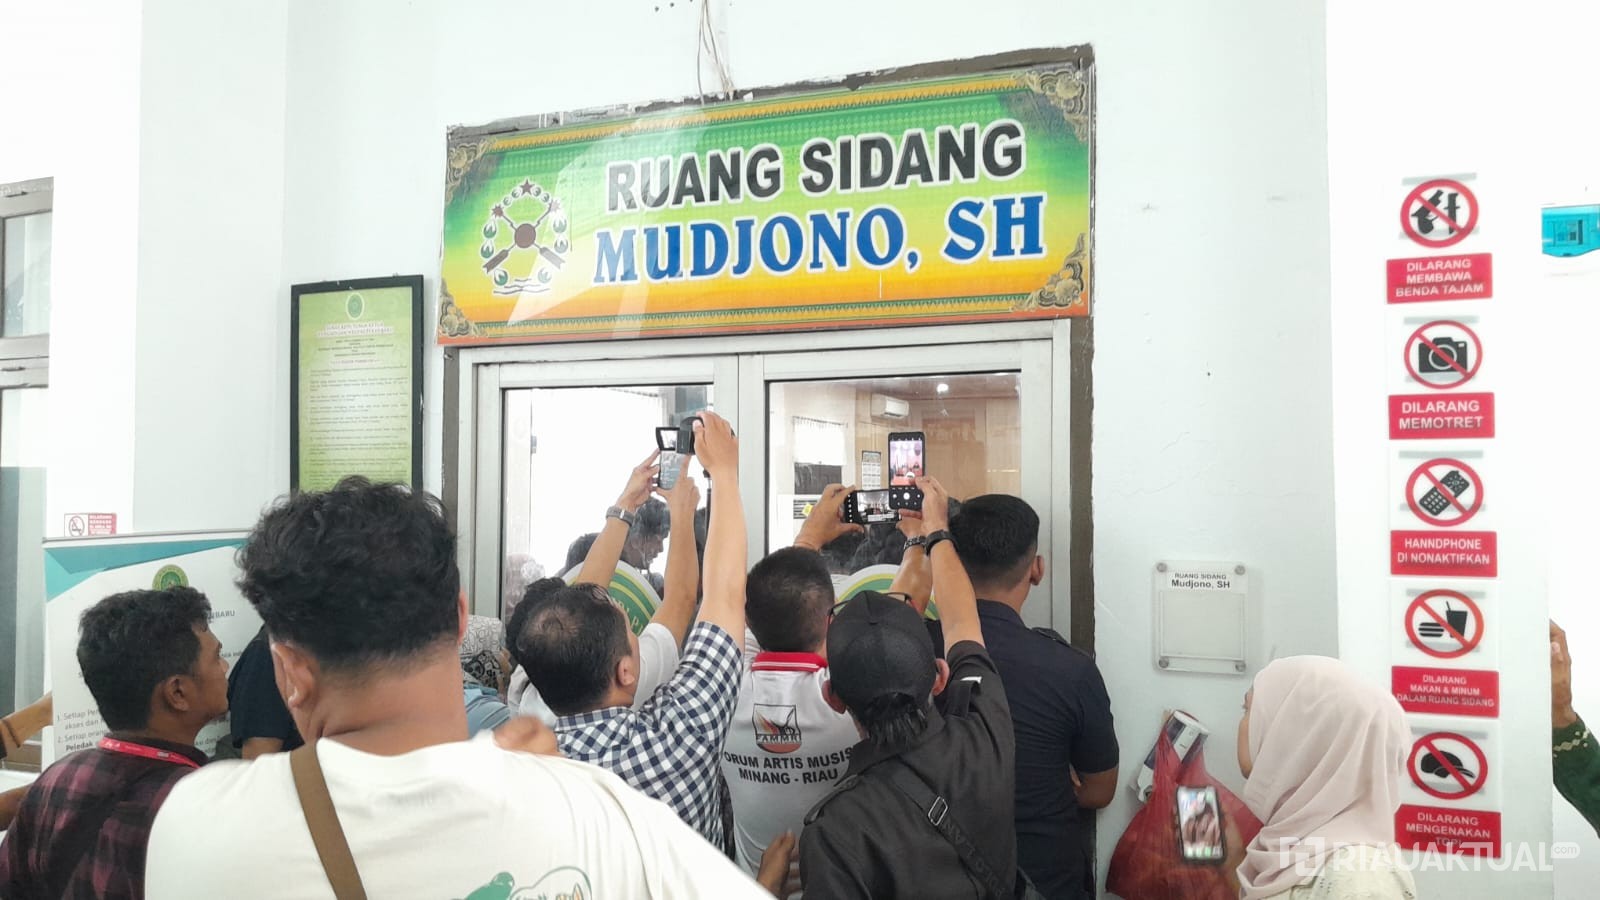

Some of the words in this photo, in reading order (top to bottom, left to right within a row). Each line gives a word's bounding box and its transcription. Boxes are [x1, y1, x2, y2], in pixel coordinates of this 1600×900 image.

[608, 147, 781, 211] RUANG
[802, 123, 1022, 193] SIDANG
[594, 207, 918, 283] MUDJONO,
[943, 196, 1043, 260] SH
[1406, 259, 1472, 272] DILARANG
[1406, 272, 1472, 285] MEMBAWA
[1395, 286, 1439, 297] BENDA
[1442, 283, 1484, 294] TAJAM
[1402, 400, 1480, 414] DILARANG
[1399, 416, 1483, 430] MEMOTRET
[1405, 538, 1482, 550] HANNDPHONE
[1397, 552, 1408, 563] DI
[1410, 553, 1490, 565] NONAKTIFKAN
[1171, 579, 1214, 589] Mudjono,
[1217, 580, 1231, 588] SH
[1423, 675, 1467, 685] DILARANG
[1410, 684, 1441, 694] MAKAN
[1443, 685, 1449, 694] &
[1451, 686, 1480, 695] MINUM
[1397, 694, 1427, 703] DALAM
[1429, 695, 1459, 705] RUANG
[1461, 698, 1494, 708] SIDANG
[724, 751, 759, 768] ORUM
[763, 757, 803, 769] ARTIS
[808, 747, 854, 769] MUSIS
[738, 767, 790, 785] MINANG
[803, 769, 838, 784] RIAU
[1417, 812, 1479, 826] DILARANG
[1406, 823, 1491, 839] MENGENAKAN
